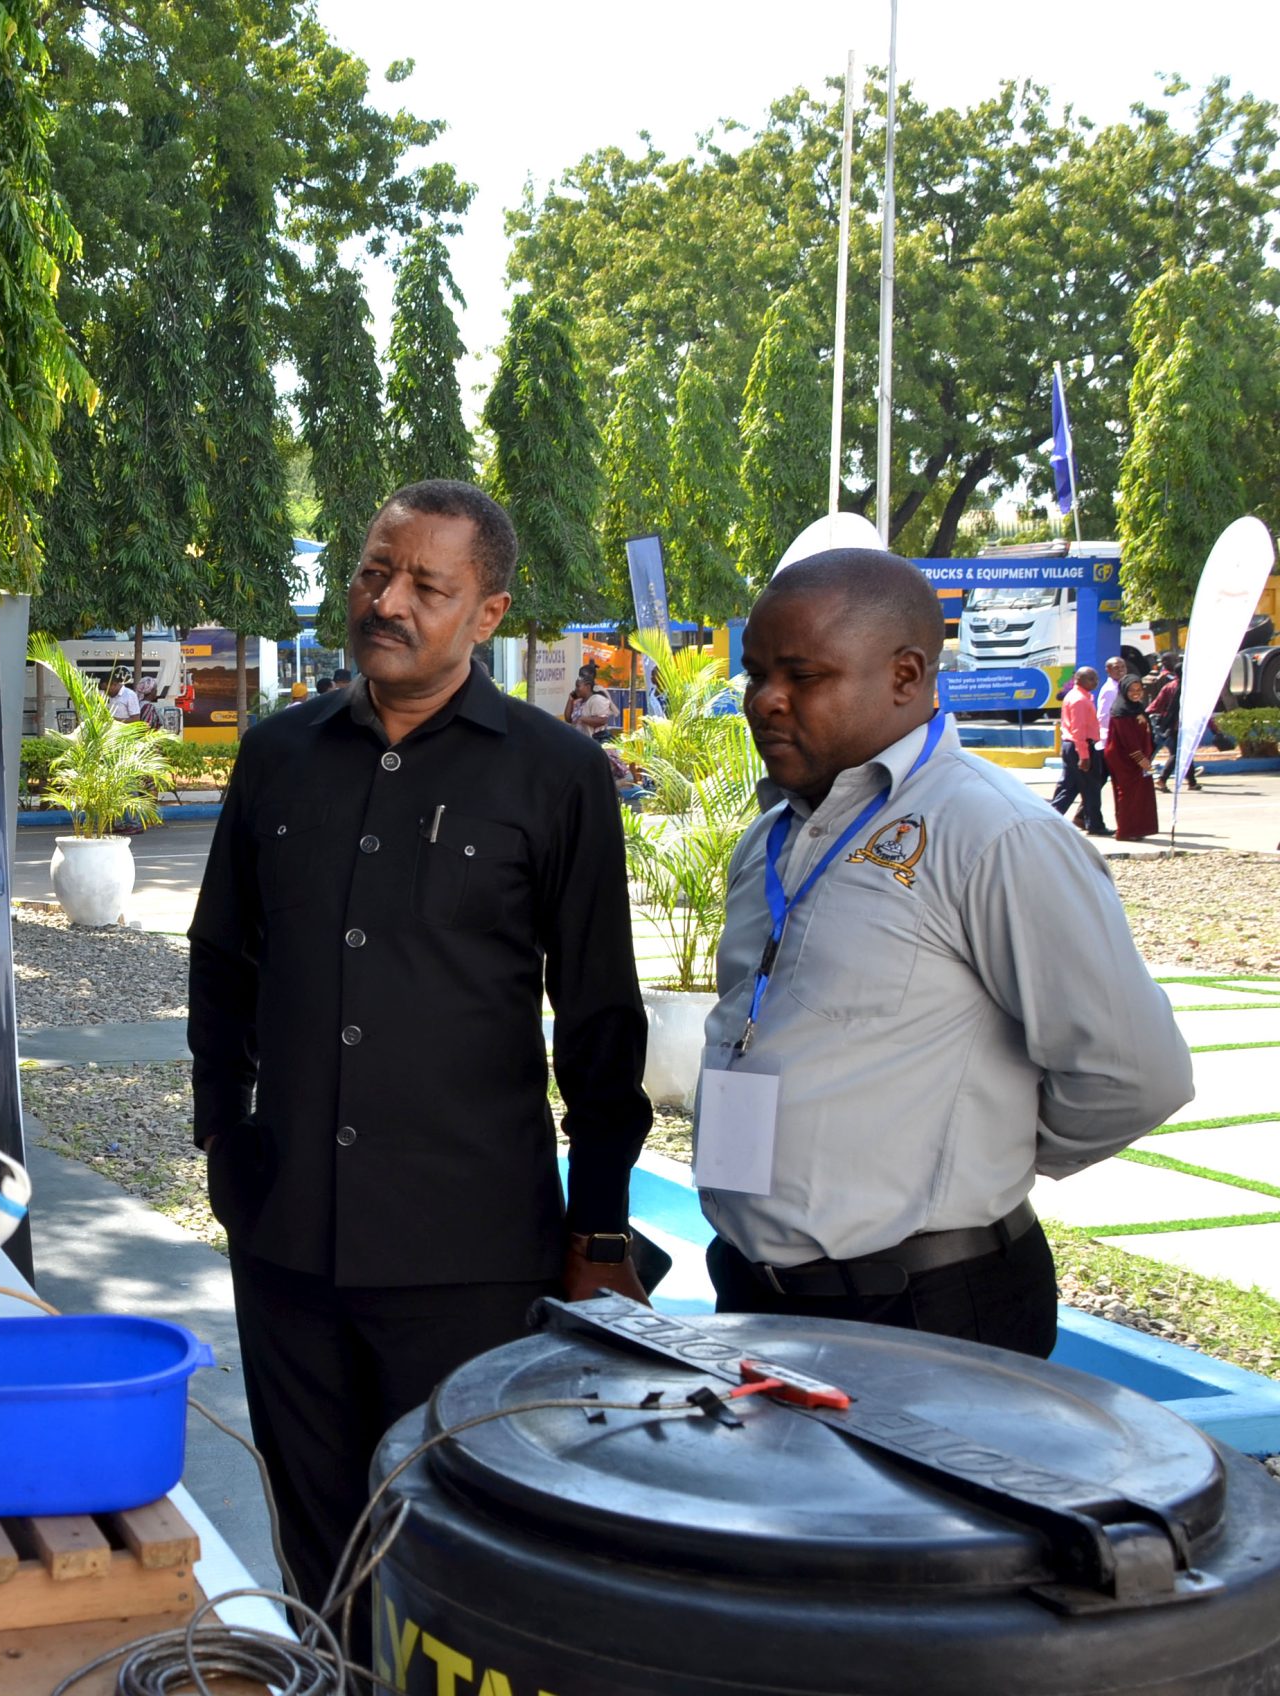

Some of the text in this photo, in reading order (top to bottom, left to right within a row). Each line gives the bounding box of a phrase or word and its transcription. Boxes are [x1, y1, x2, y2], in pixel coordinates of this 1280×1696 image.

[920, 567, 1084, 580] TRUCKS & EQUIPMENT VILLAGE
[535, 668, 566, 681] EQUIPMENT
